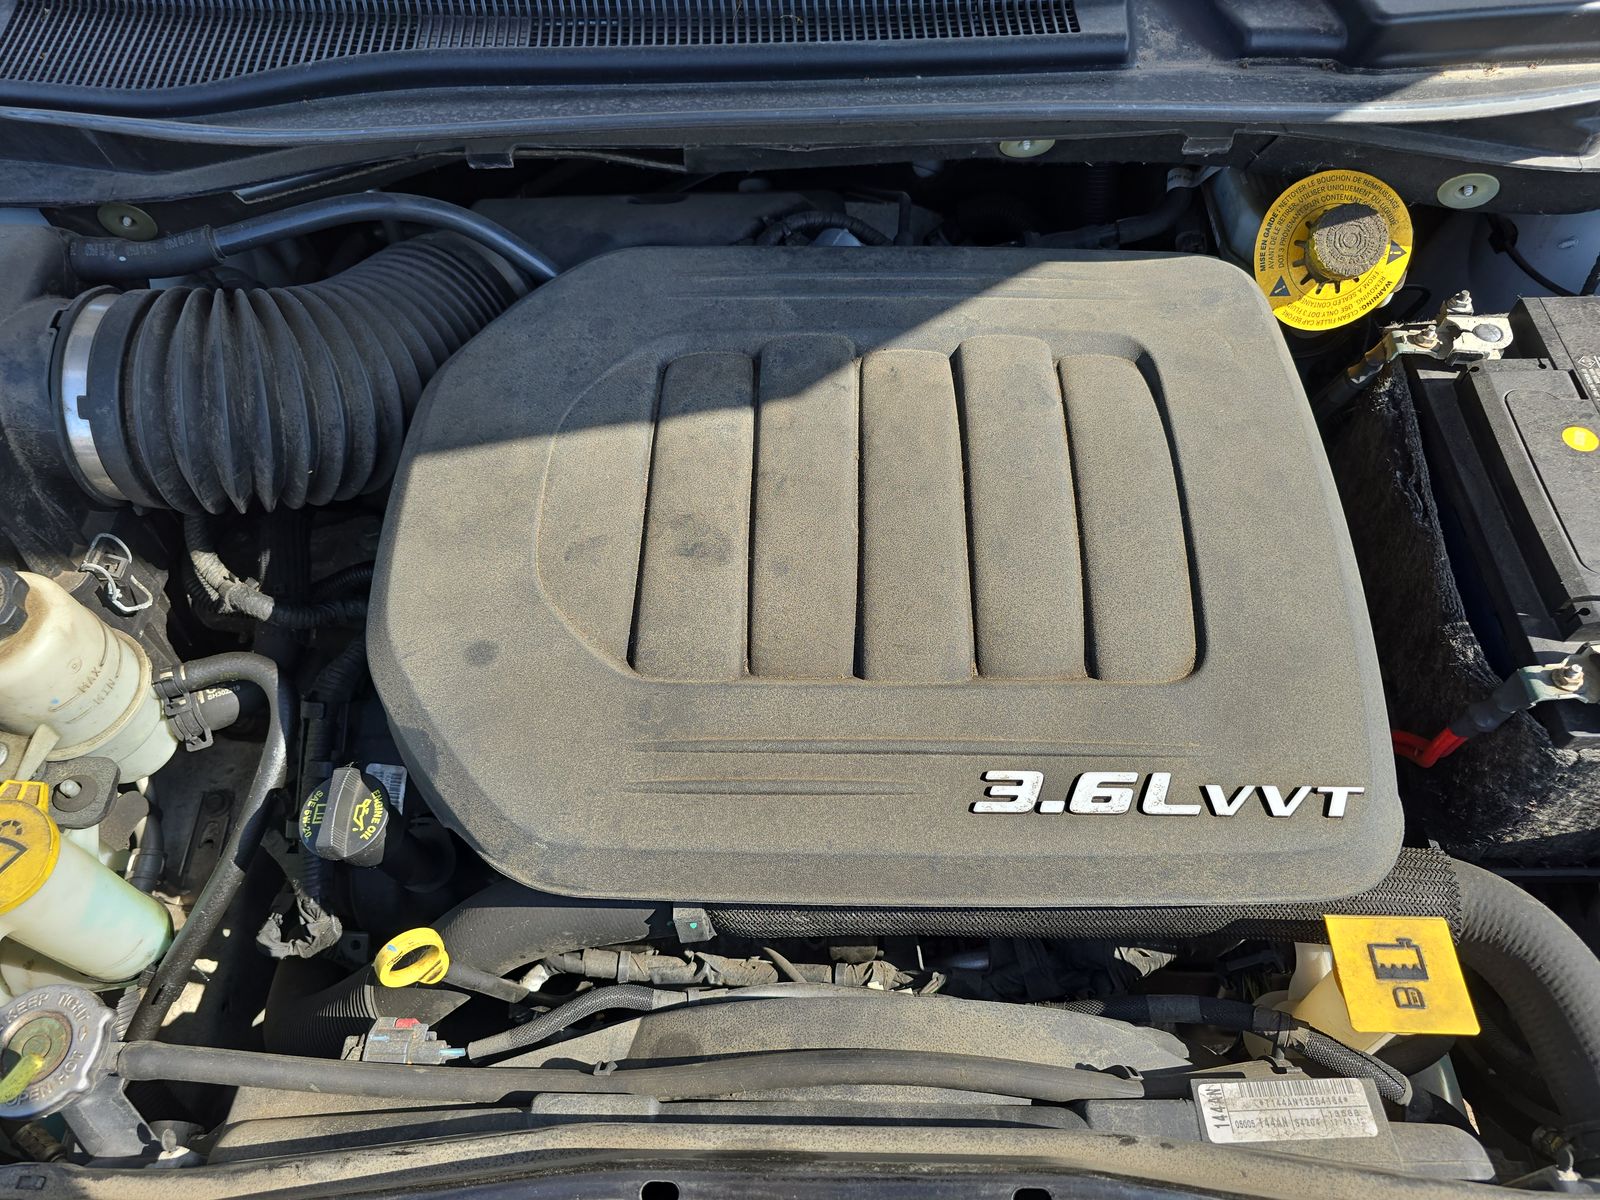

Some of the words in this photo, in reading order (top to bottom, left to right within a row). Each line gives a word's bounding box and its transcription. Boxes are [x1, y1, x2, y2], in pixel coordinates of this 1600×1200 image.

[1297, 185, 1326, 204] UTILISER
[1320, 193, 1361, 204] CONTENANT
[1326, 184, 1371, 198] UNIQUEMENT
[1370, 194, 1381, 204] DU
[1260, 239, 1268, 250] EN
[1277, 183, 1307, 209] NETTOYER
[1306, 179, 1316, 188] LE
[1317, 174, 1352, 184] BOUCHON
[1352, 176, 1362, 184] DE
[1361, 179, 1400, 210] REMPLISSAGE
[1271, 225, 1281, 235] LE
[1279, 208, 1304, 246] PROVENANT
[1269, 235, 1277, 245] DE
[1267, 245, 1275, 271] AVANT
[1277, 253, 1285, 269] DOT
[1362, 270, 1380, 290] FROM
[1332, 291, 1358, 306] SEALED
[1307, 310, 1320, 318] DOT
[1337, 308, 1359, 322] CLEAN
[1340, 302, 1353, 313] USE
[1281, 309, 1302, 324] BEFORE
[1300, 318, 1315, 326] CAP
[1315, 318, 1336, 326] FILLER
[307, 790, 324, 807] SAE
[969, 770, 1201, 815] 3.6L
[1201, 784, 1365, 818] VVT
[371, 789, 385, 825] ENGINE
[360, 826, 377, 841] OIL
[7, 992, 49, 1023] KEEP
[58, 993, 91, 1021] TIGHT
[1206, 1087, 1230, 1129] 144AN
